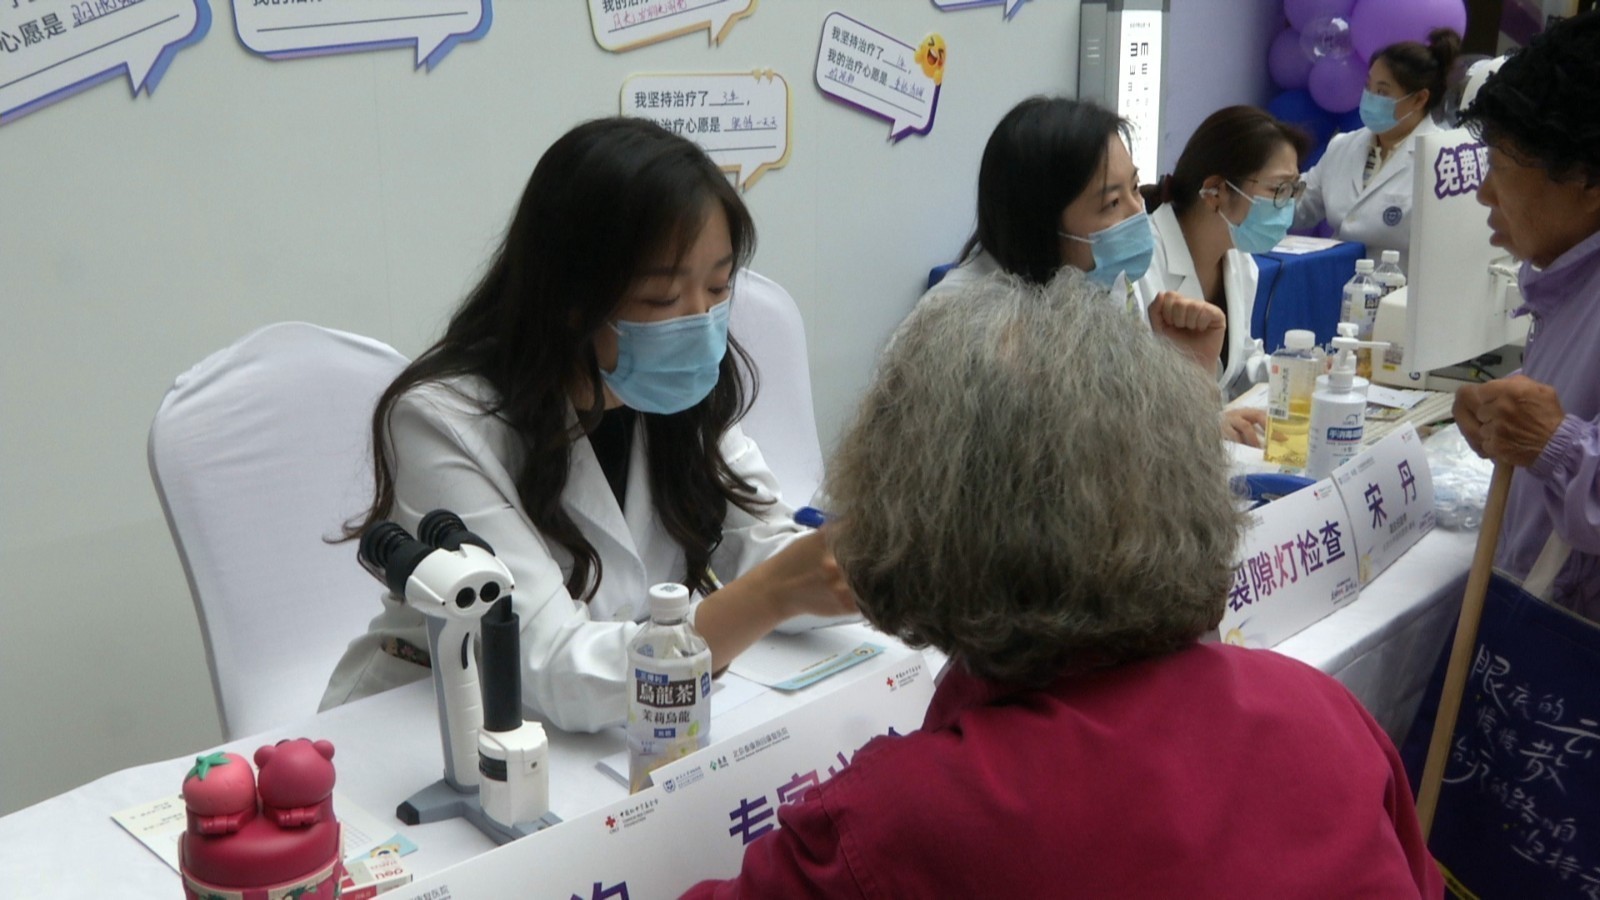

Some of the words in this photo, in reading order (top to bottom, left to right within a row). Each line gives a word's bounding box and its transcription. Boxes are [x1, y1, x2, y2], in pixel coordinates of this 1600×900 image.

[1229, 519, 1346, 612] 裂隙灯检查
[639, 683, 694, 706] 烏龍茶
